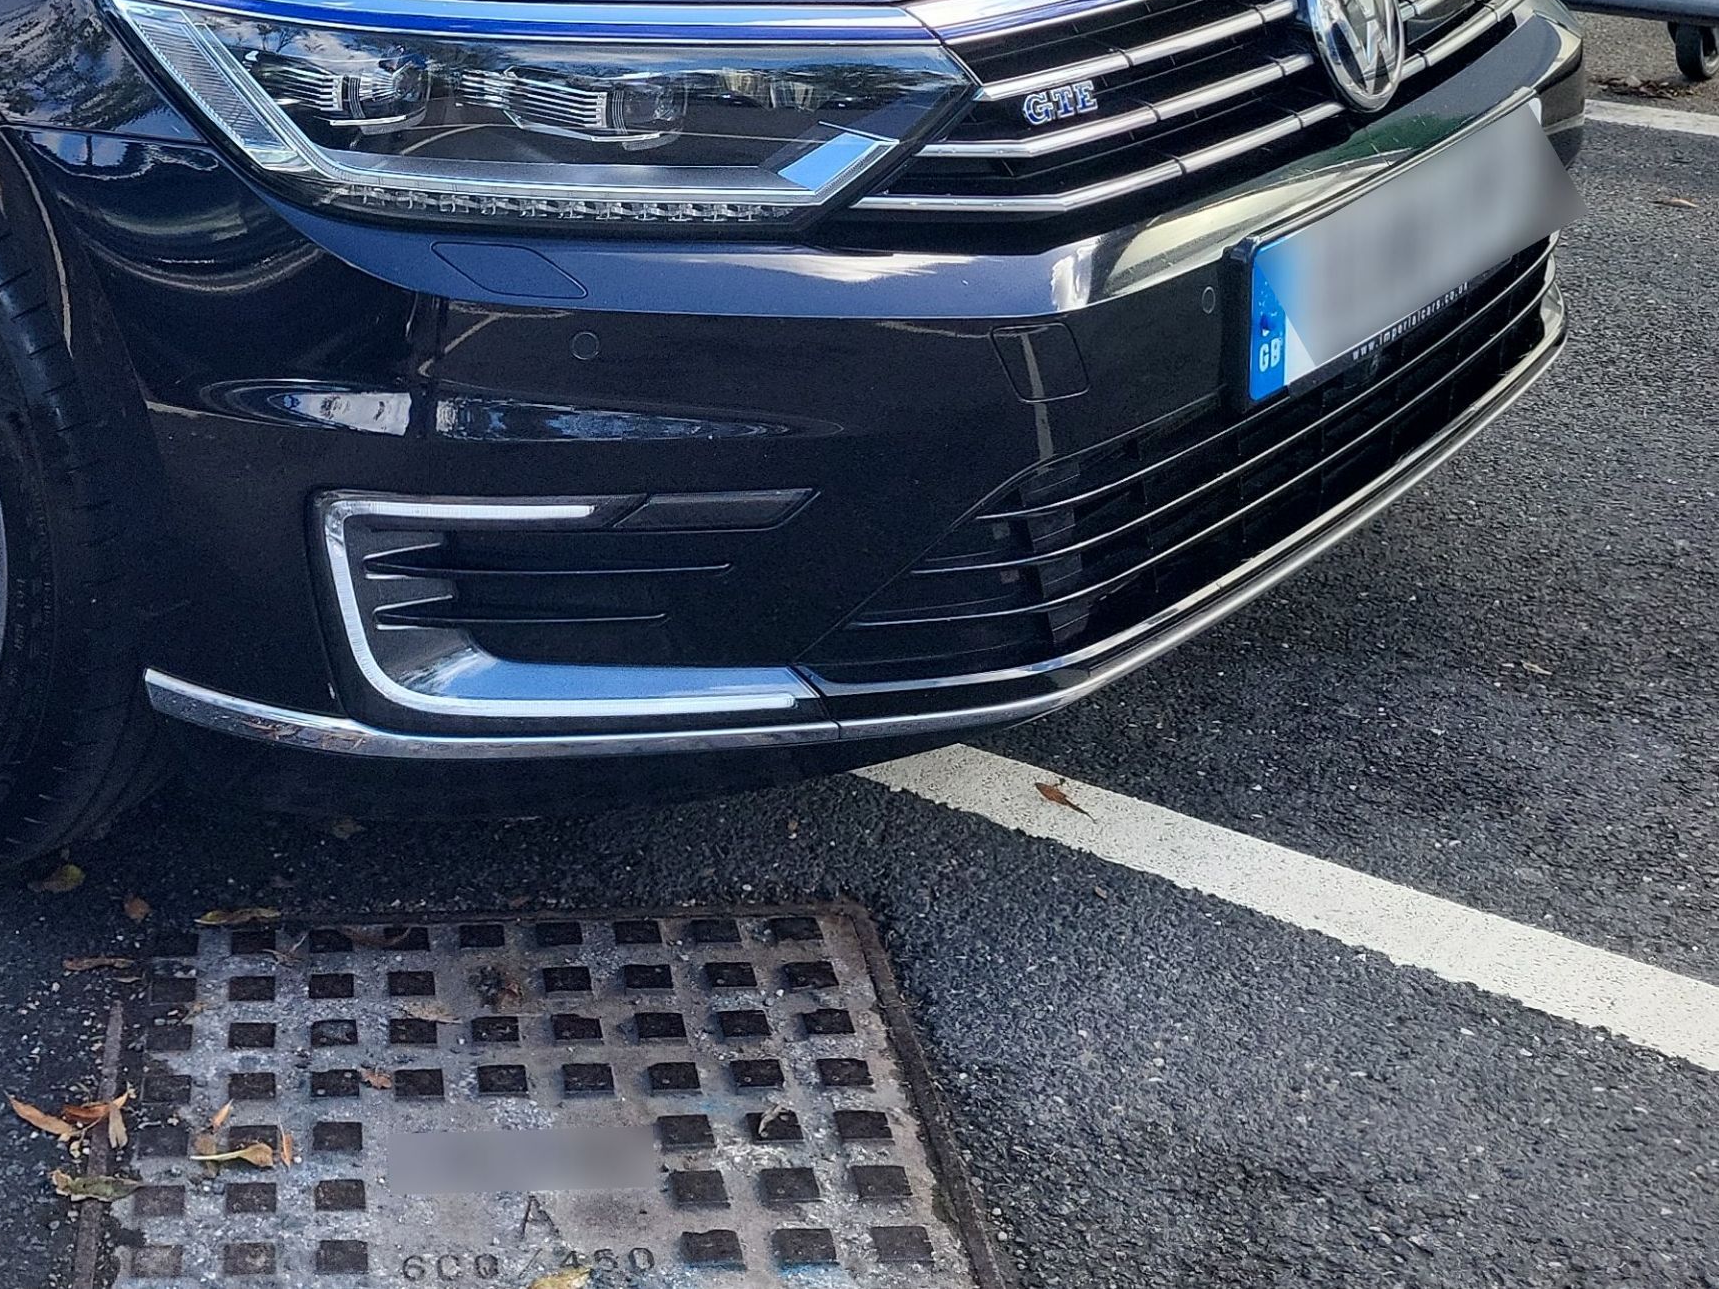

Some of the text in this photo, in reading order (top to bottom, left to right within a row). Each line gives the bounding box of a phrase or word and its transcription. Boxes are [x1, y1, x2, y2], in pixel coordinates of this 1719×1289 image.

[1023, 79, 1098, 126] GTE
[1352, 281, 1469, 360] www.imperialcars.co.uk
[1259, 337, 1282, 372] GB
